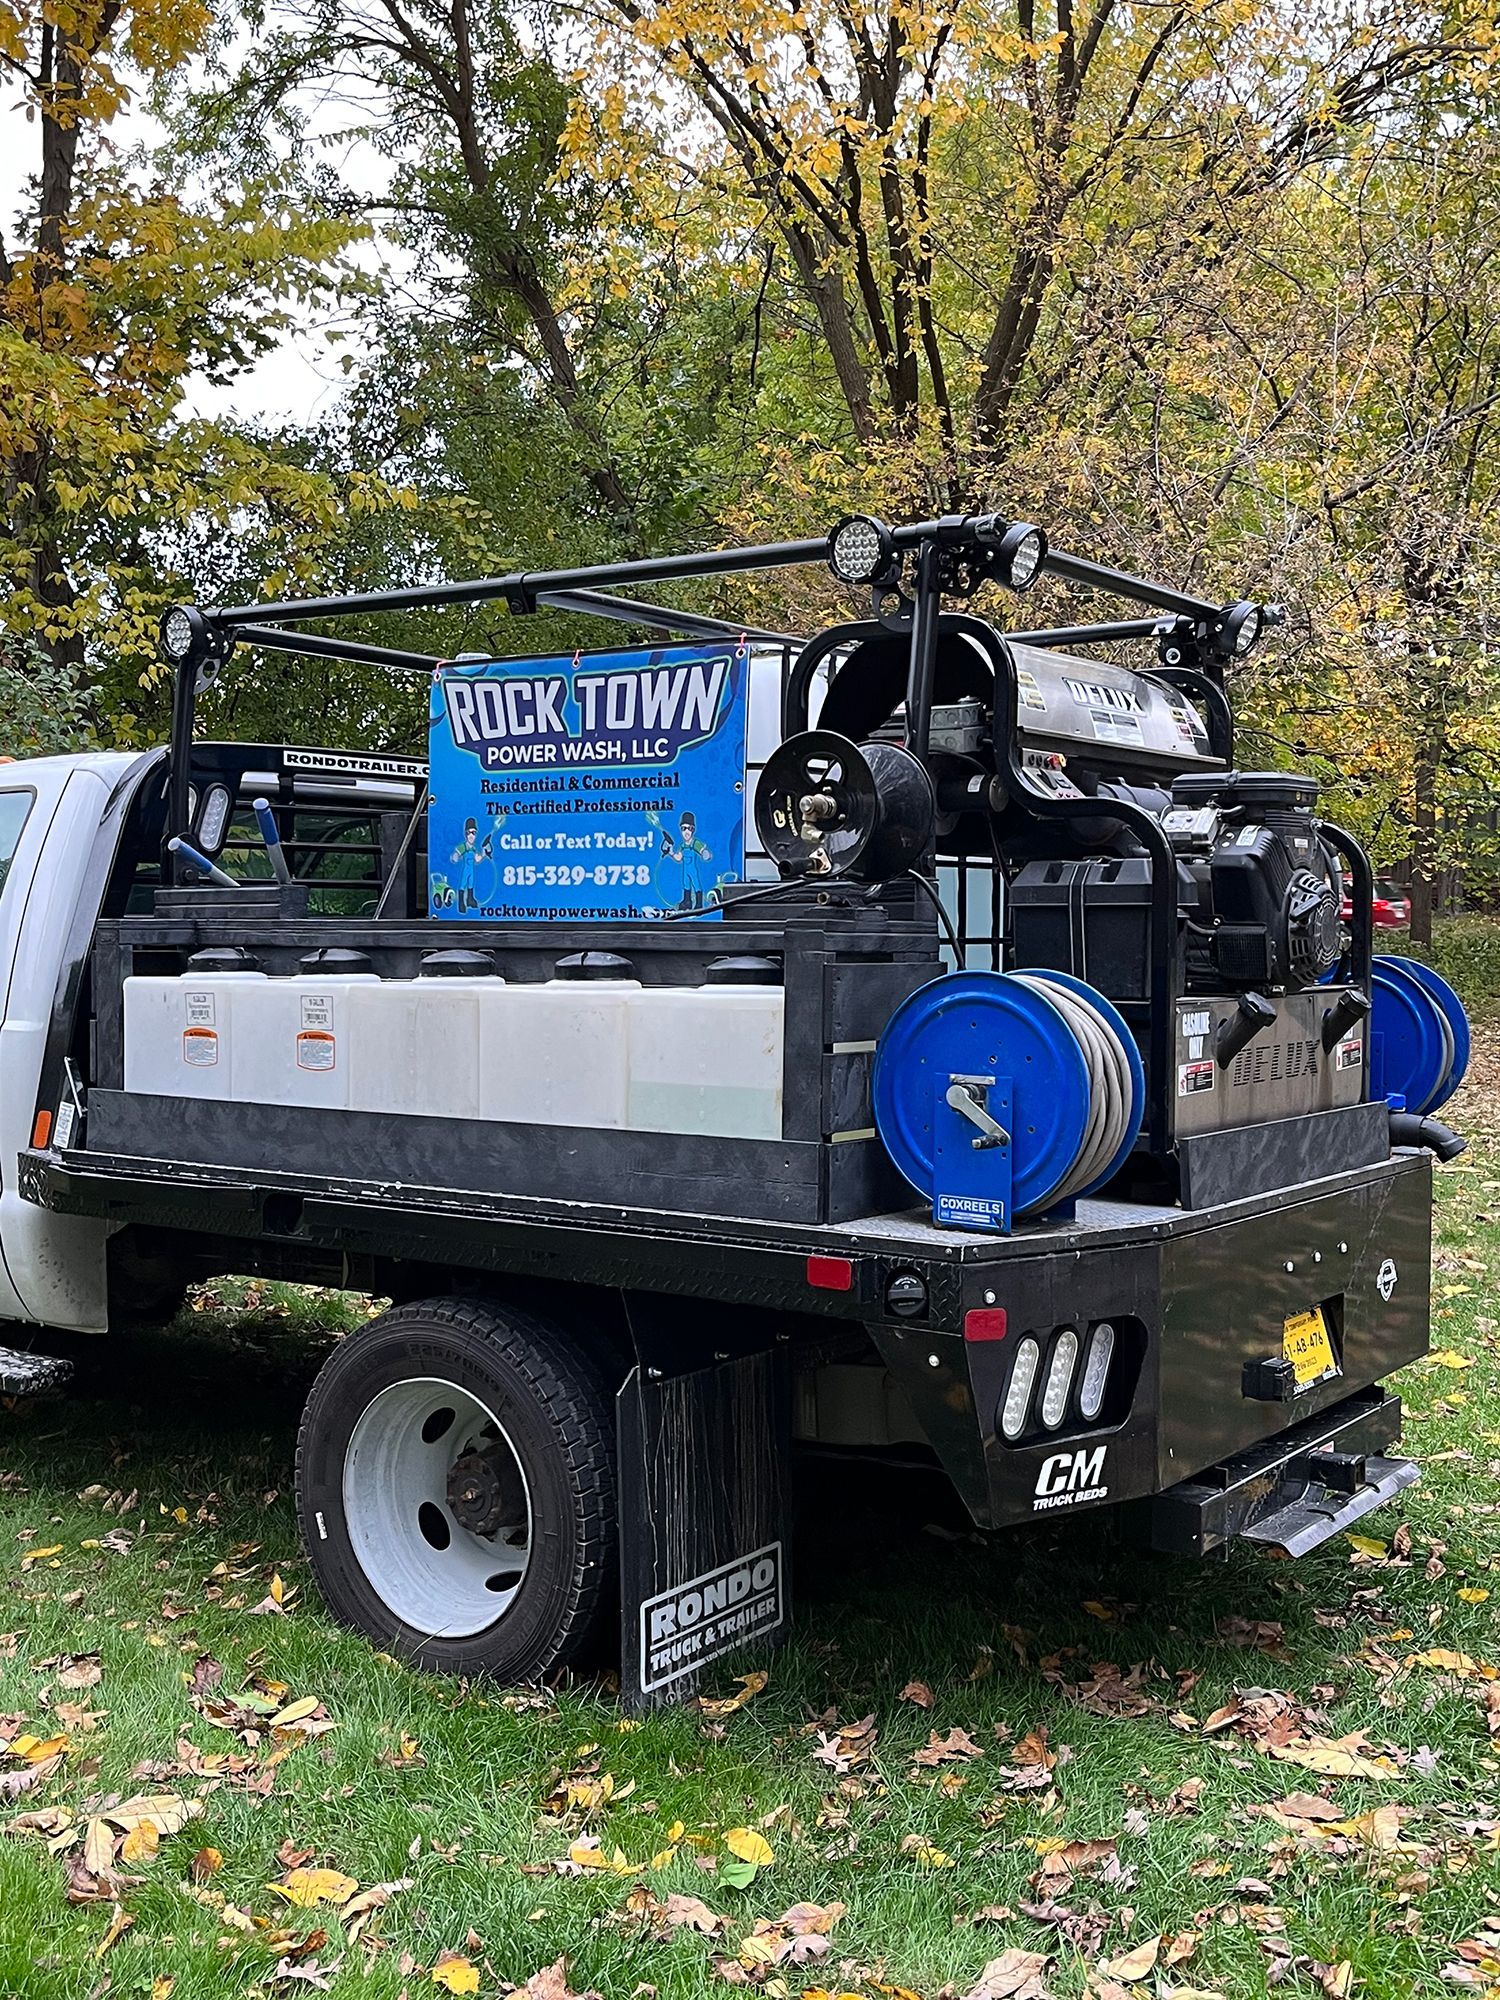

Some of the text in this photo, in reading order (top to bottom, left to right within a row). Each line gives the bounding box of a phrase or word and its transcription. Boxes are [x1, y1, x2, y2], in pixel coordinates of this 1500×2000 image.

[445, 662, 726, 744] ROCK TOWN
[487, 738, 669, 765] POWER WASH, LLC
[480, 772, 680, 794] Residential & Commercial
[486, 797, 674, 816] The Certified Professionals
[500, 832, 654, 851] Call or Text Today!
[503, 865, 650, 887] 815-329-8738
[940, 1197, 1000, 1215] COXREELS
[1035, 1445, 1107, 1496] CM
[1033, 1486, 1108, 1511] TRUCK BEDS
[650, 1558, 775, 1642] RONDO
[650, 1597, 776, 1672] TRUCK & TRAILER
